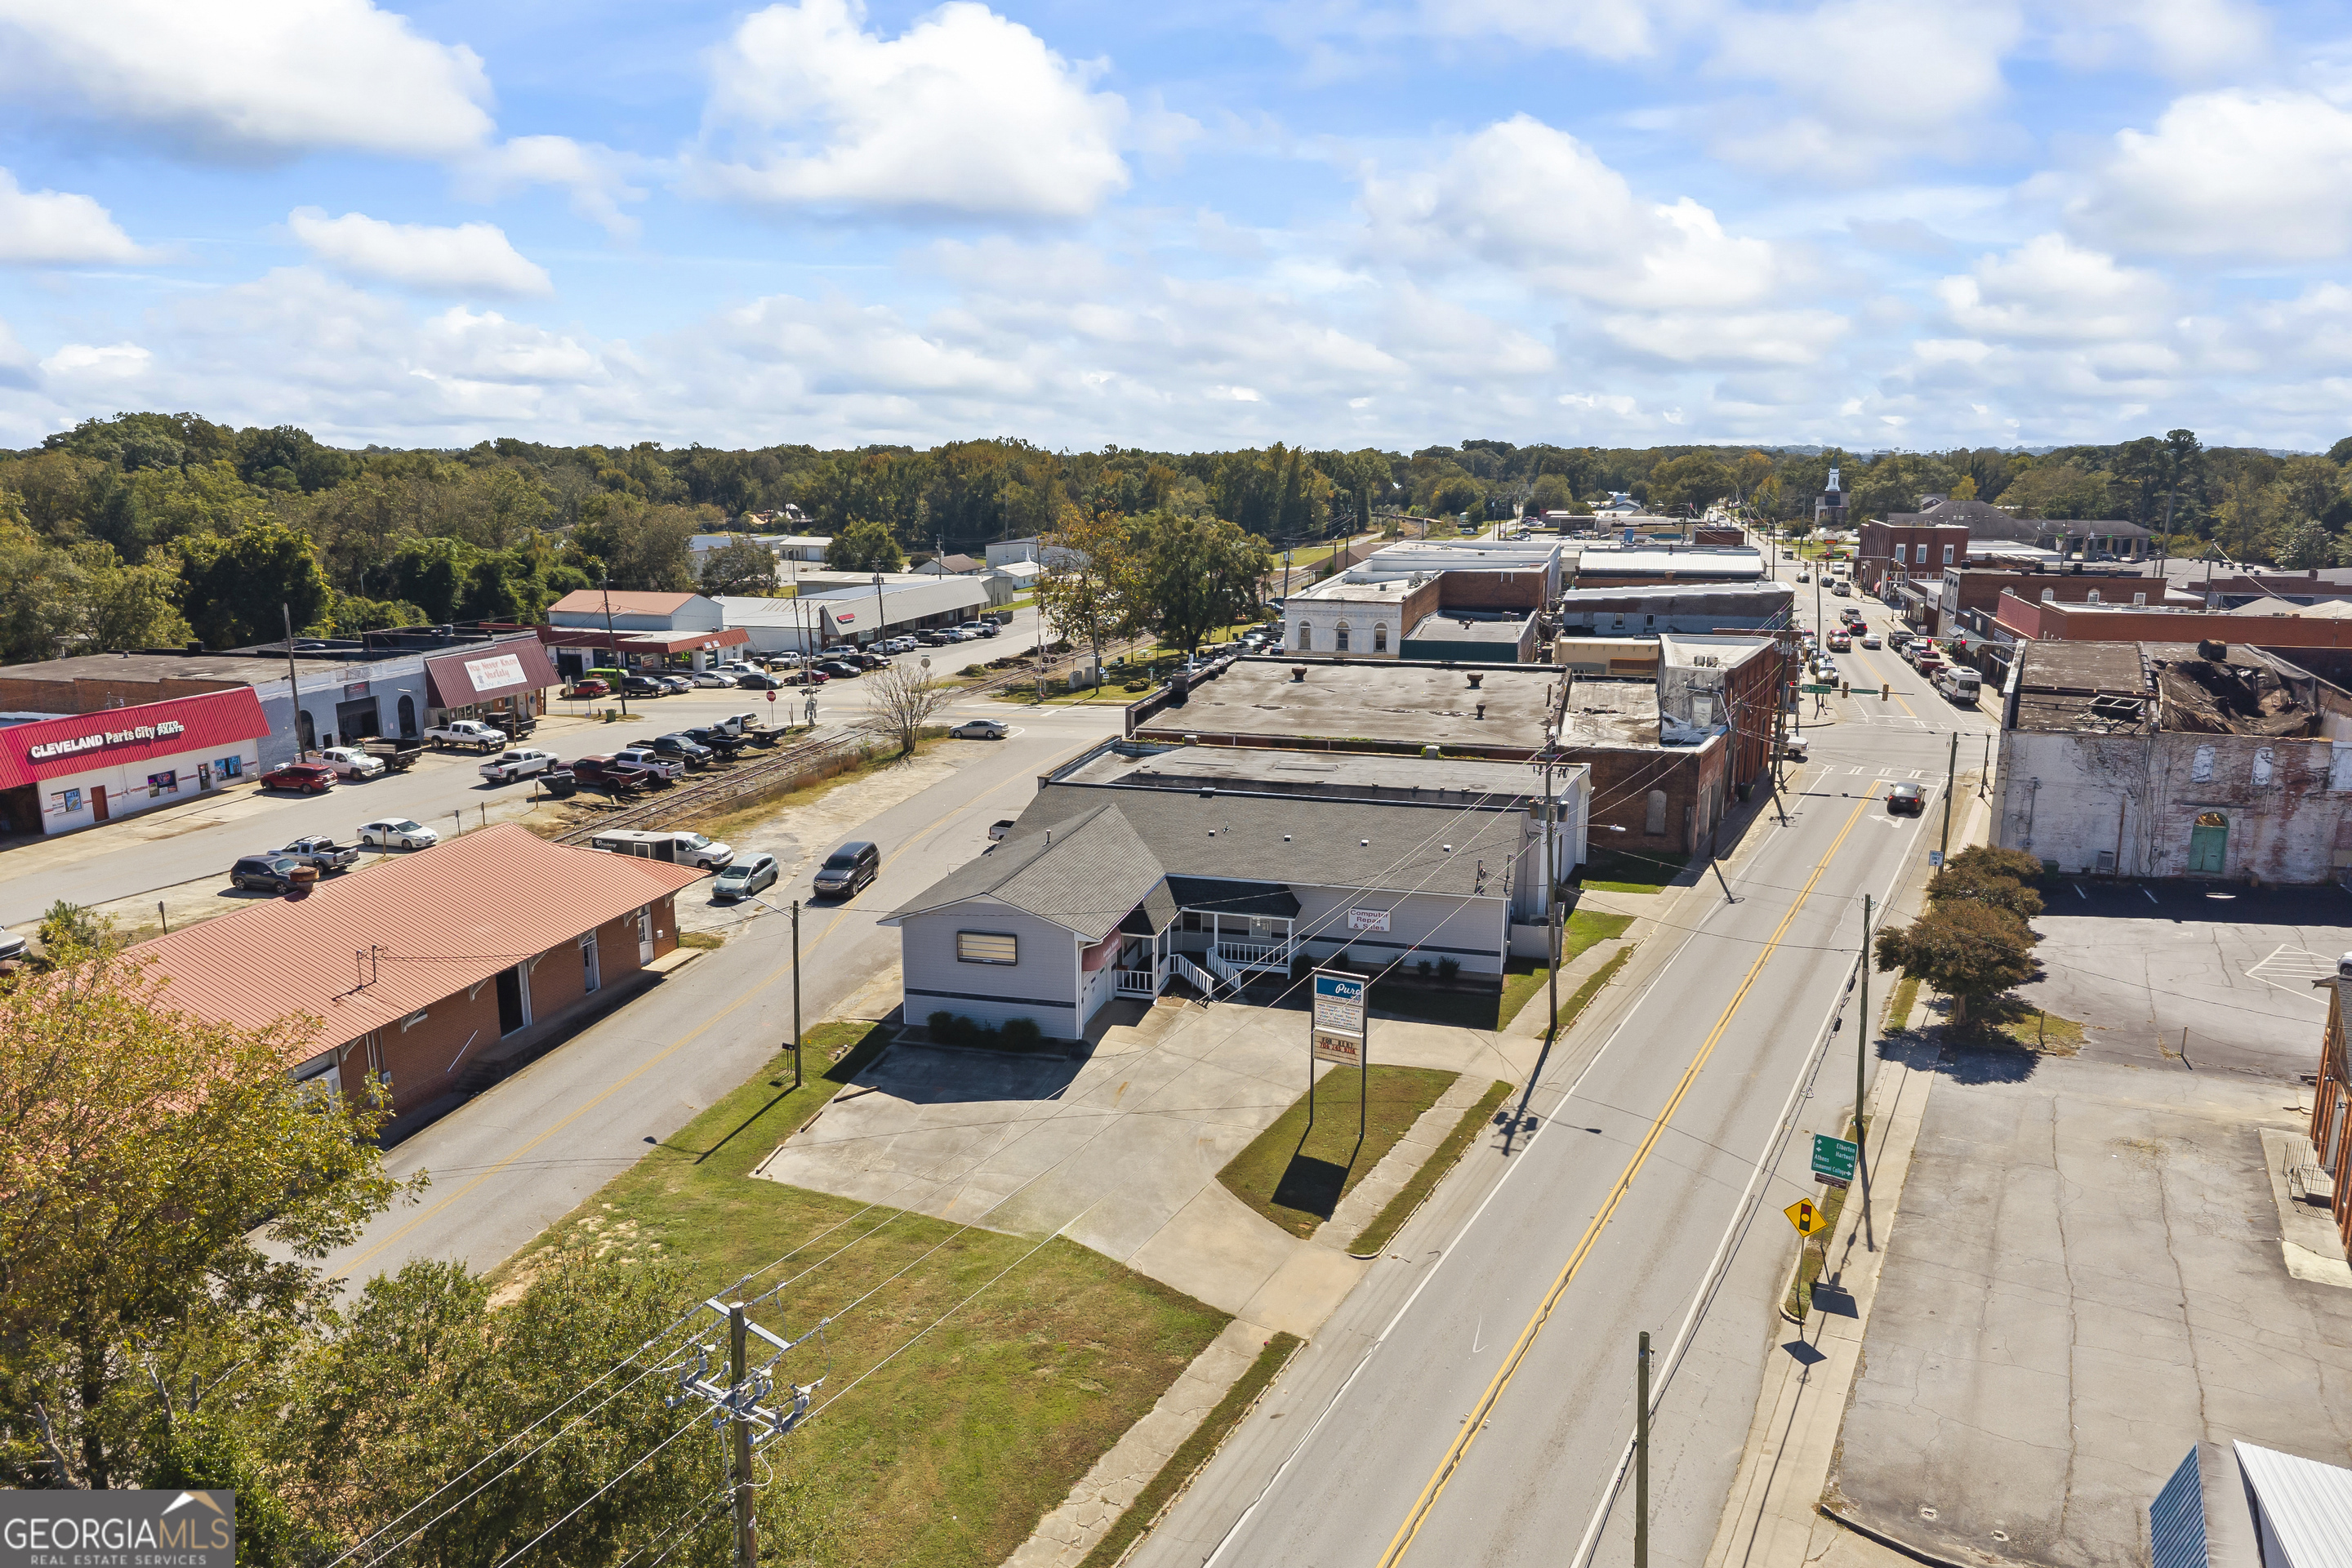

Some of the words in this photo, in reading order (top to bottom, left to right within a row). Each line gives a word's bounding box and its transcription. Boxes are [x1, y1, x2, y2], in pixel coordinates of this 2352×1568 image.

[468, 664, 480, 672] You
[481, 661, 498, 670] Never
[500, 657, 518, 667] Know
[484, 669, 510, 679] Variety
[157, 721, 178, 730] AUTO
[158, 725, 185, 735] PARTS
[31, 734, 103, 758] CLEVELAND
[105, 729, 134, 744] Parts
[135, 725, 156, 739] City
[1335, 983, 1361, 996] Pure
[1836, 1143, 1855, 1153] Elberton
[1814, 1154, 1829, 1162] Athens
[1836, 1152, 1854, 1161] Hartwell
[1813, 1161, 1832, 1171] Emmanuel
[1832, 1167, 1846, 1176] College
